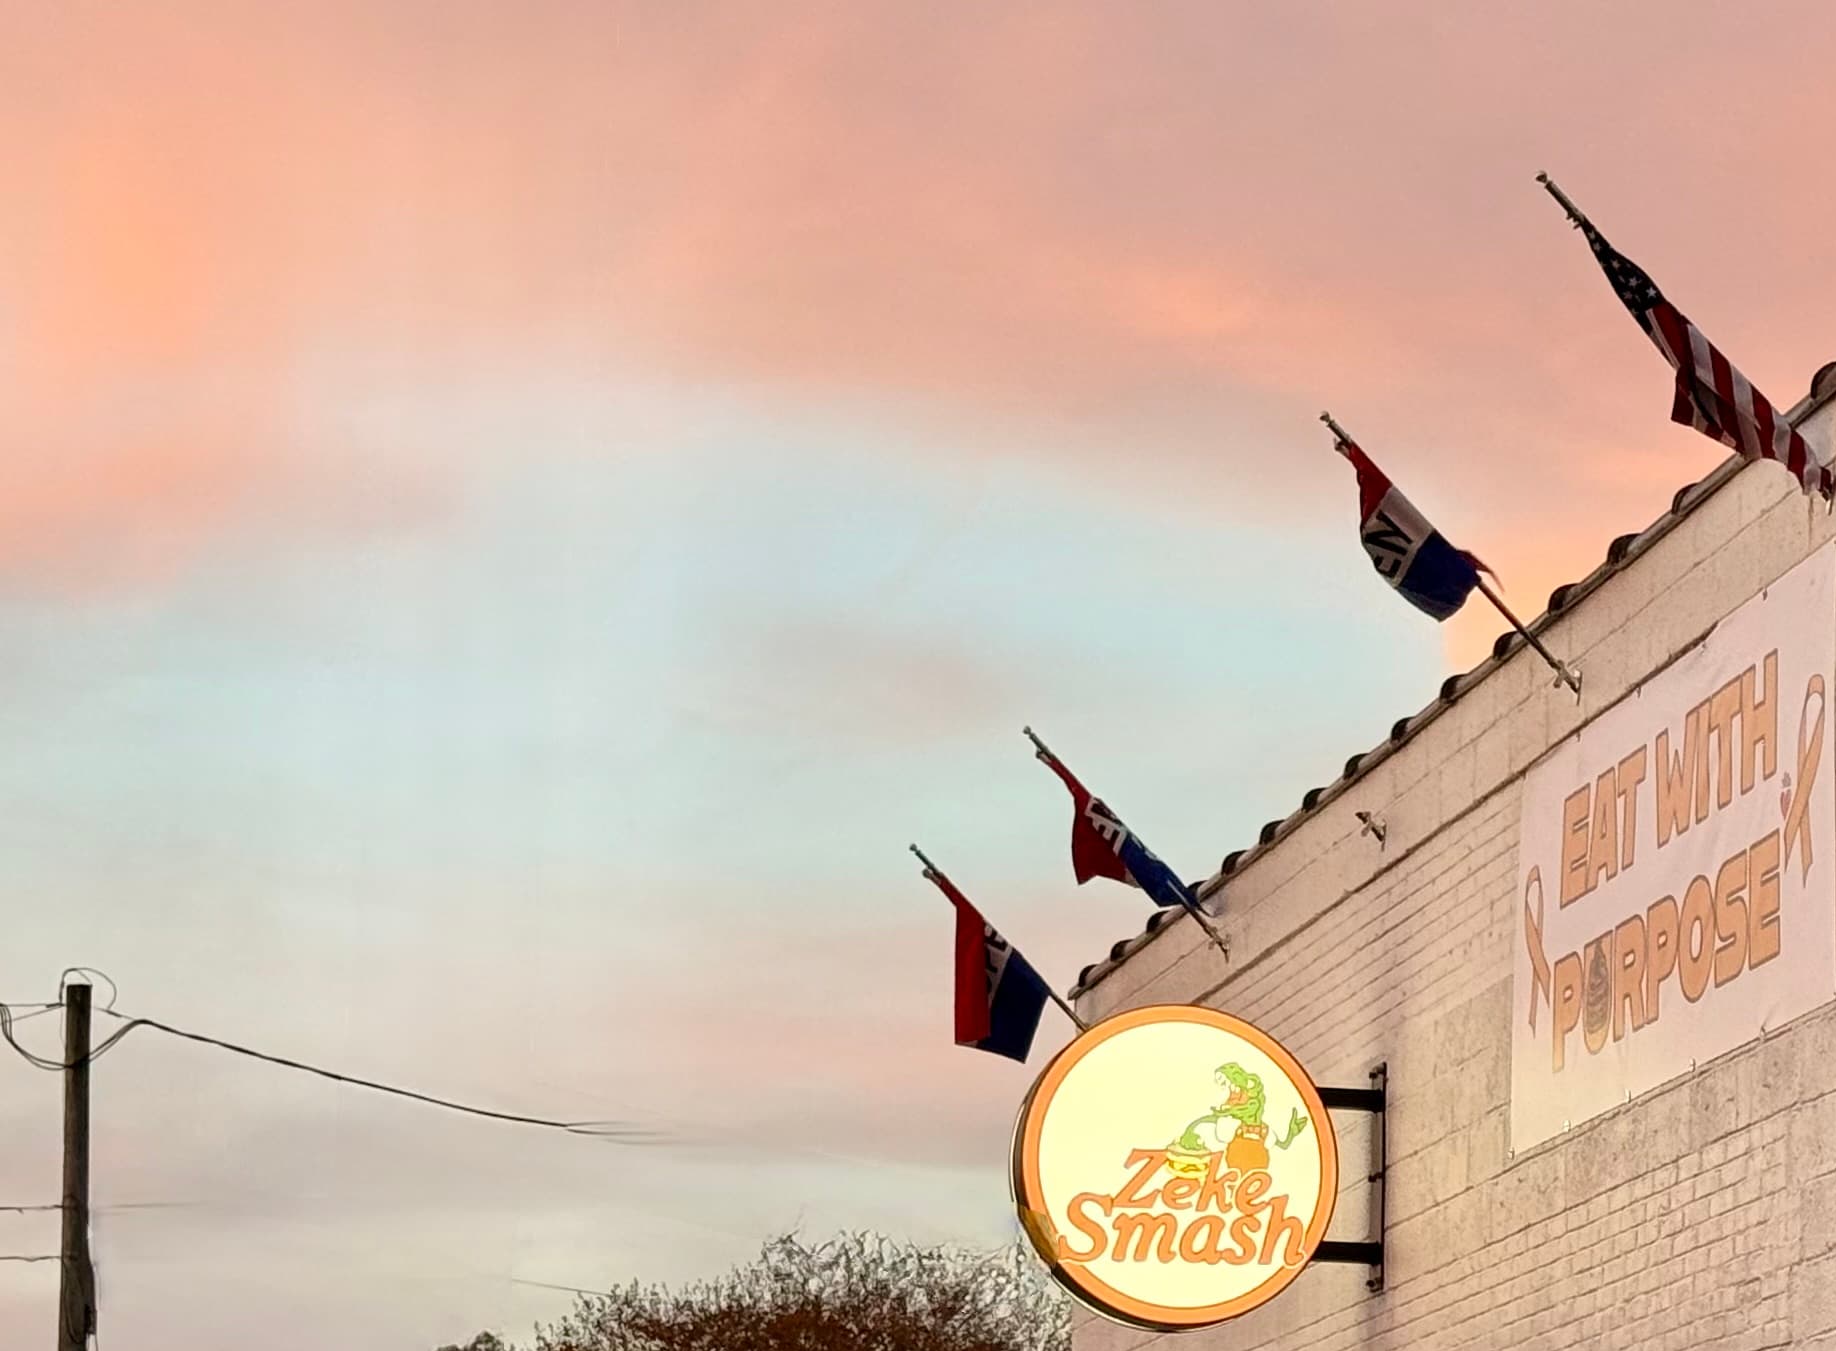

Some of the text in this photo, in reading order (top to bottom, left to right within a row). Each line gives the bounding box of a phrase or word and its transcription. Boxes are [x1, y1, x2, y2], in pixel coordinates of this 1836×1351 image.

[1560, 648, 1778, 908] EAT WITH
[1552, 829, 1781, 1073] PURPOSE
[1058, 1193, 1306, 1266] Smash
[1112, 1149, 1273, 1214] Zeke
